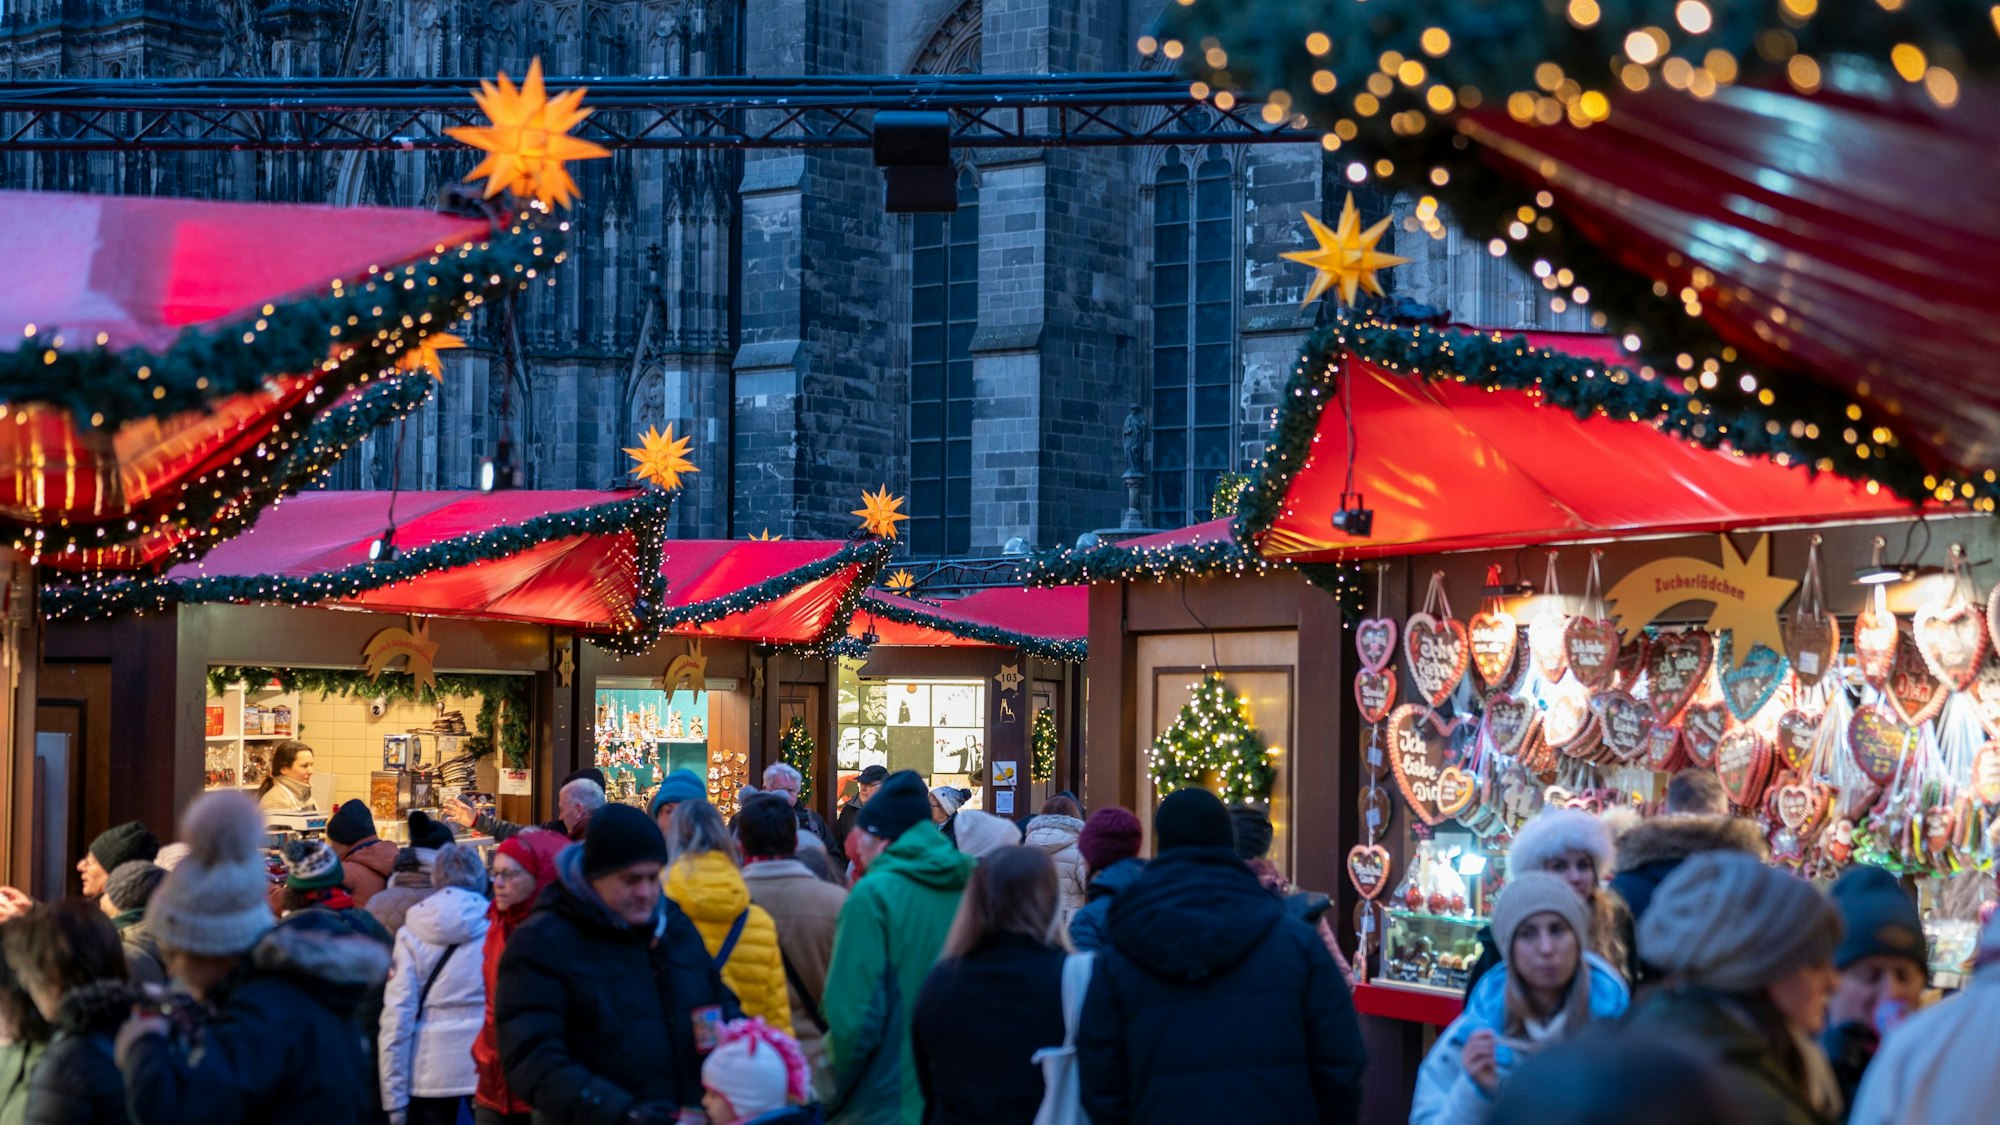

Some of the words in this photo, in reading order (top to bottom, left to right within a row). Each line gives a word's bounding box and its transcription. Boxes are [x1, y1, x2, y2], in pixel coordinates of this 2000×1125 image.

[1655, 574, 1745, 601] Zuckerlädchen
[1001, 673, 1017, 683] 103
[1399, 730, 1428, 755] Ich
[1401, 753, 1438, 780] liebe
[1412, 780, 1440, 802] Dic
